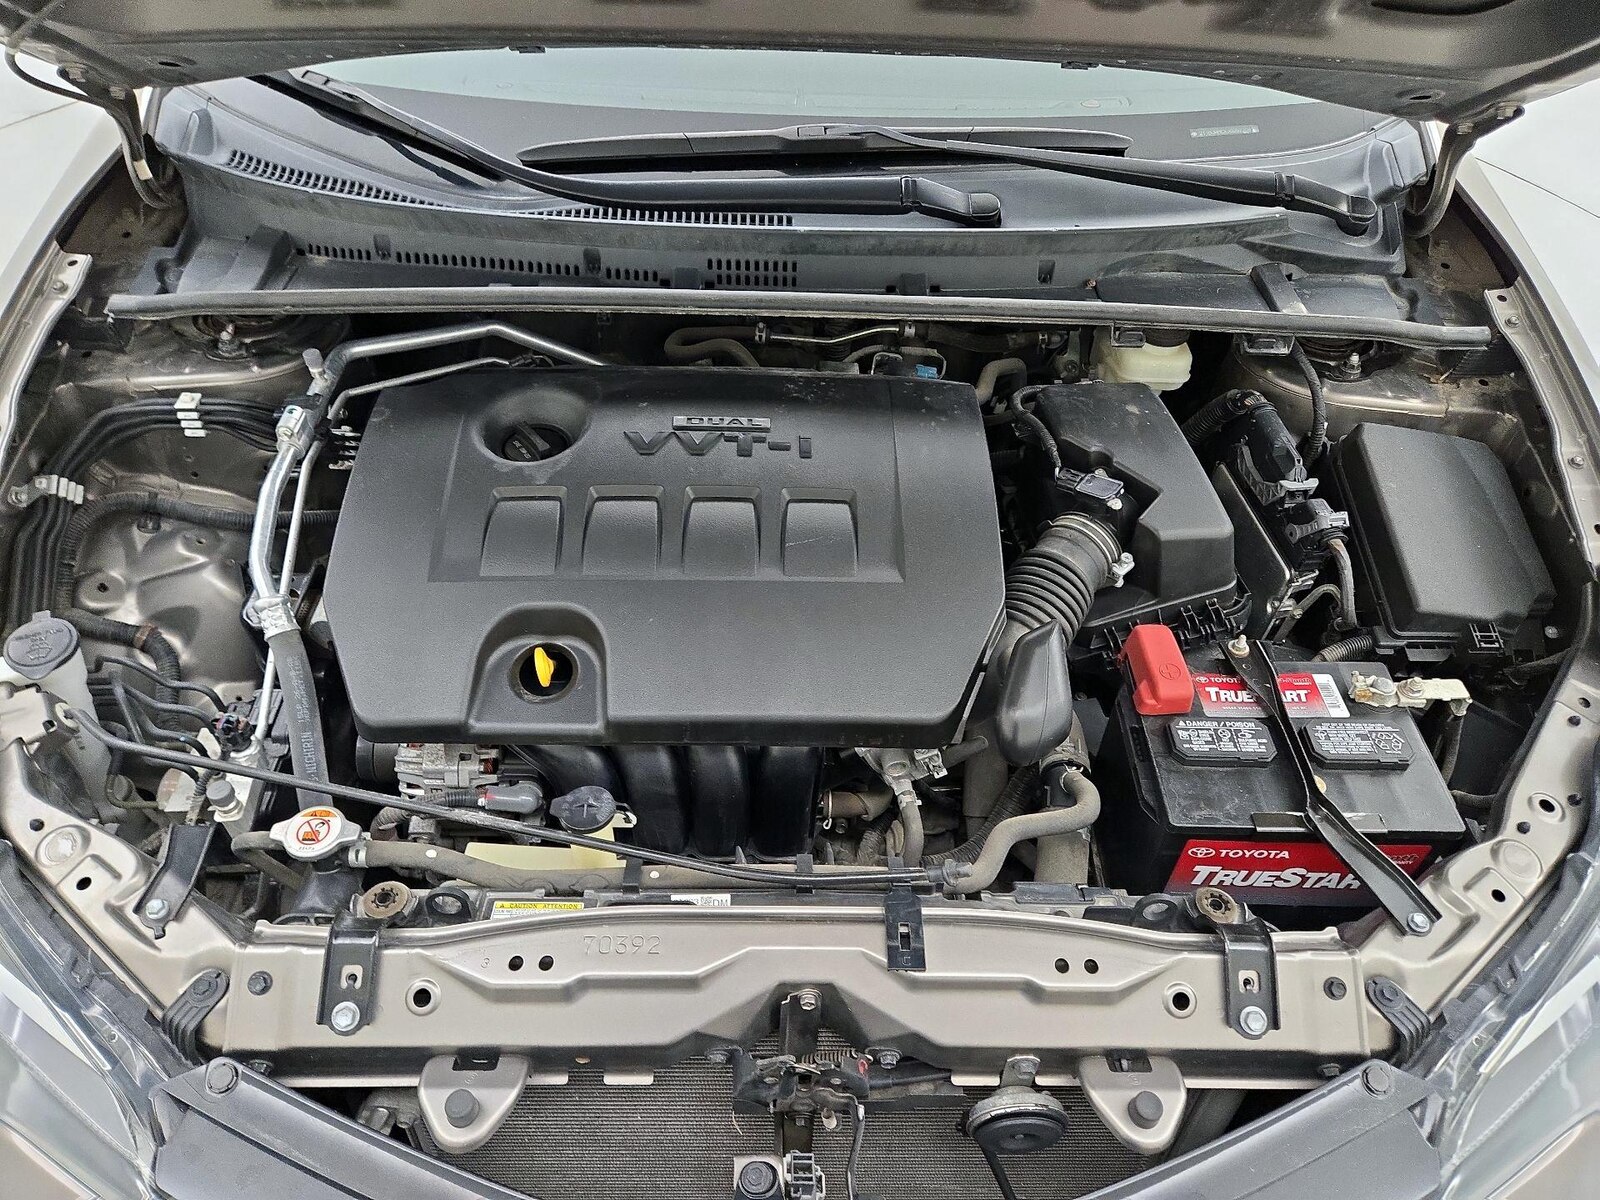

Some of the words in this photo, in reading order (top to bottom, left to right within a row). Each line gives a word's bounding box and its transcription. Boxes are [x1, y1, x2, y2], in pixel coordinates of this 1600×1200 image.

[686, 417, 762, 427] DUAL
[1226, 721, 1256, 729] POISON
[1219, 849, 1290, 859] TOYOTA
[583, 935, 662, 955] 70392
